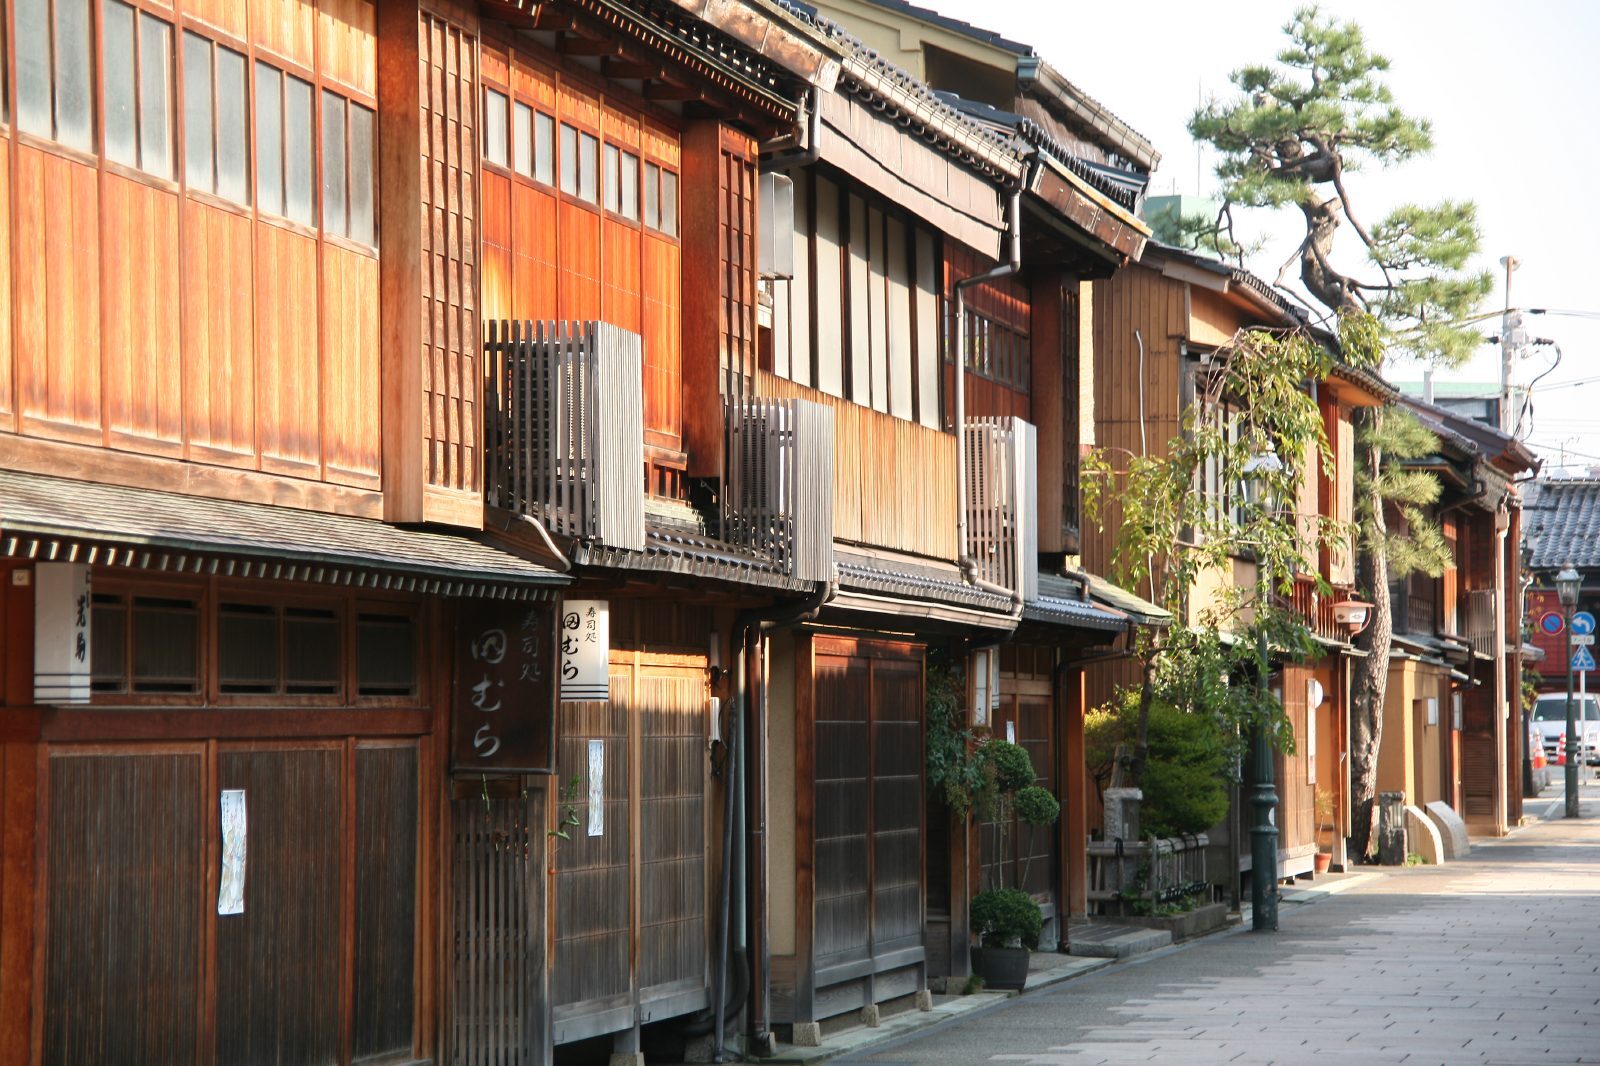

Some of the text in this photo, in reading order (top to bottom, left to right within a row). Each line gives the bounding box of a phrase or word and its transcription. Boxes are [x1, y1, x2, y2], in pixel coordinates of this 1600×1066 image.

[561, 612, 580, 680] 田むら
[584, 606, 597, 643] 寿司処
[471, 628, 508, 758] 田むら
